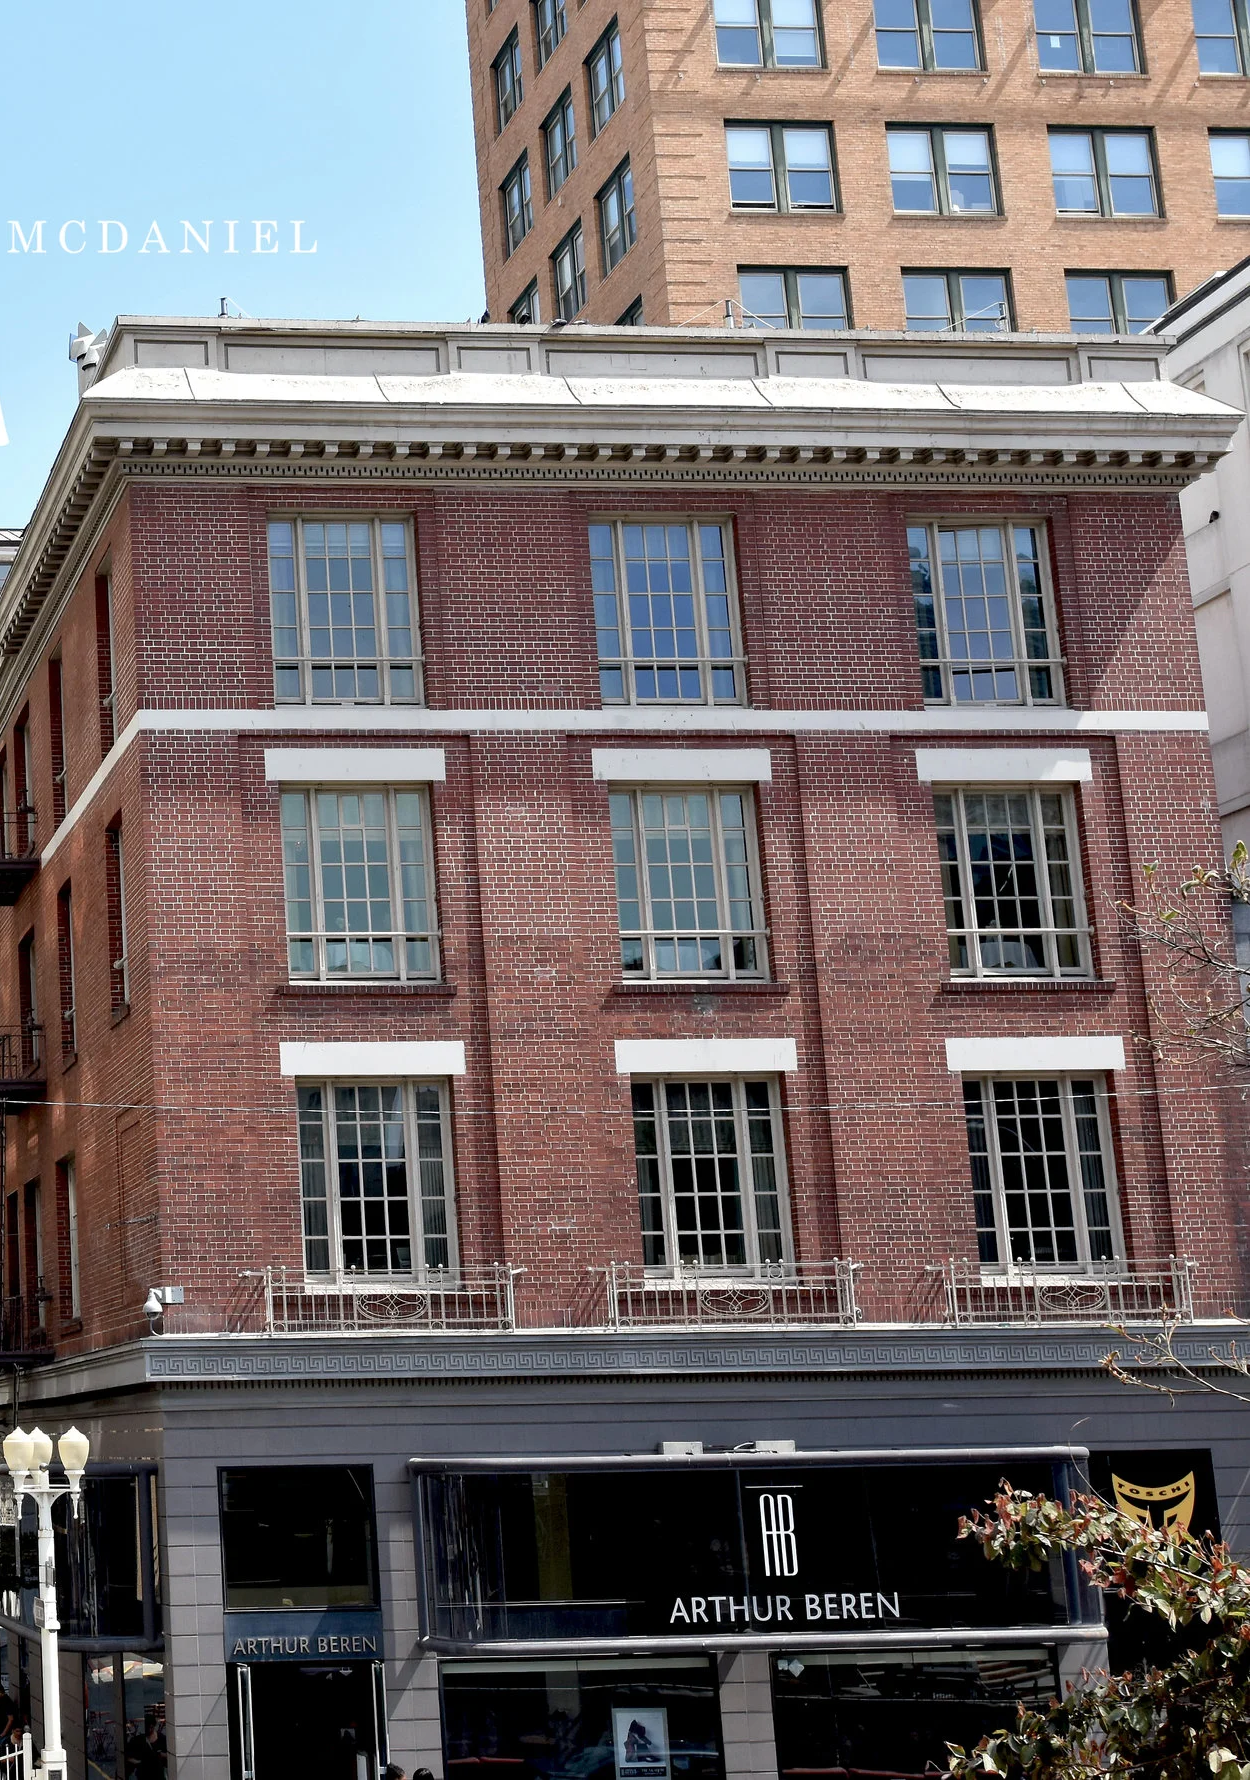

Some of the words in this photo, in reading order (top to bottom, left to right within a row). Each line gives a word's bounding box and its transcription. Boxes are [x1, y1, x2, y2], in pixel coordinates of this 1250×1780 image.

[1117, 1481, 1190, 1497] TOSCHI
[669, 1595, 793, 1624] ARTHUR
[804, 1591, 900, 1621] BEREN
[233, 1637, 310, 1655] ARTHUR
[318, 1635, 377, 1653] BEREN
